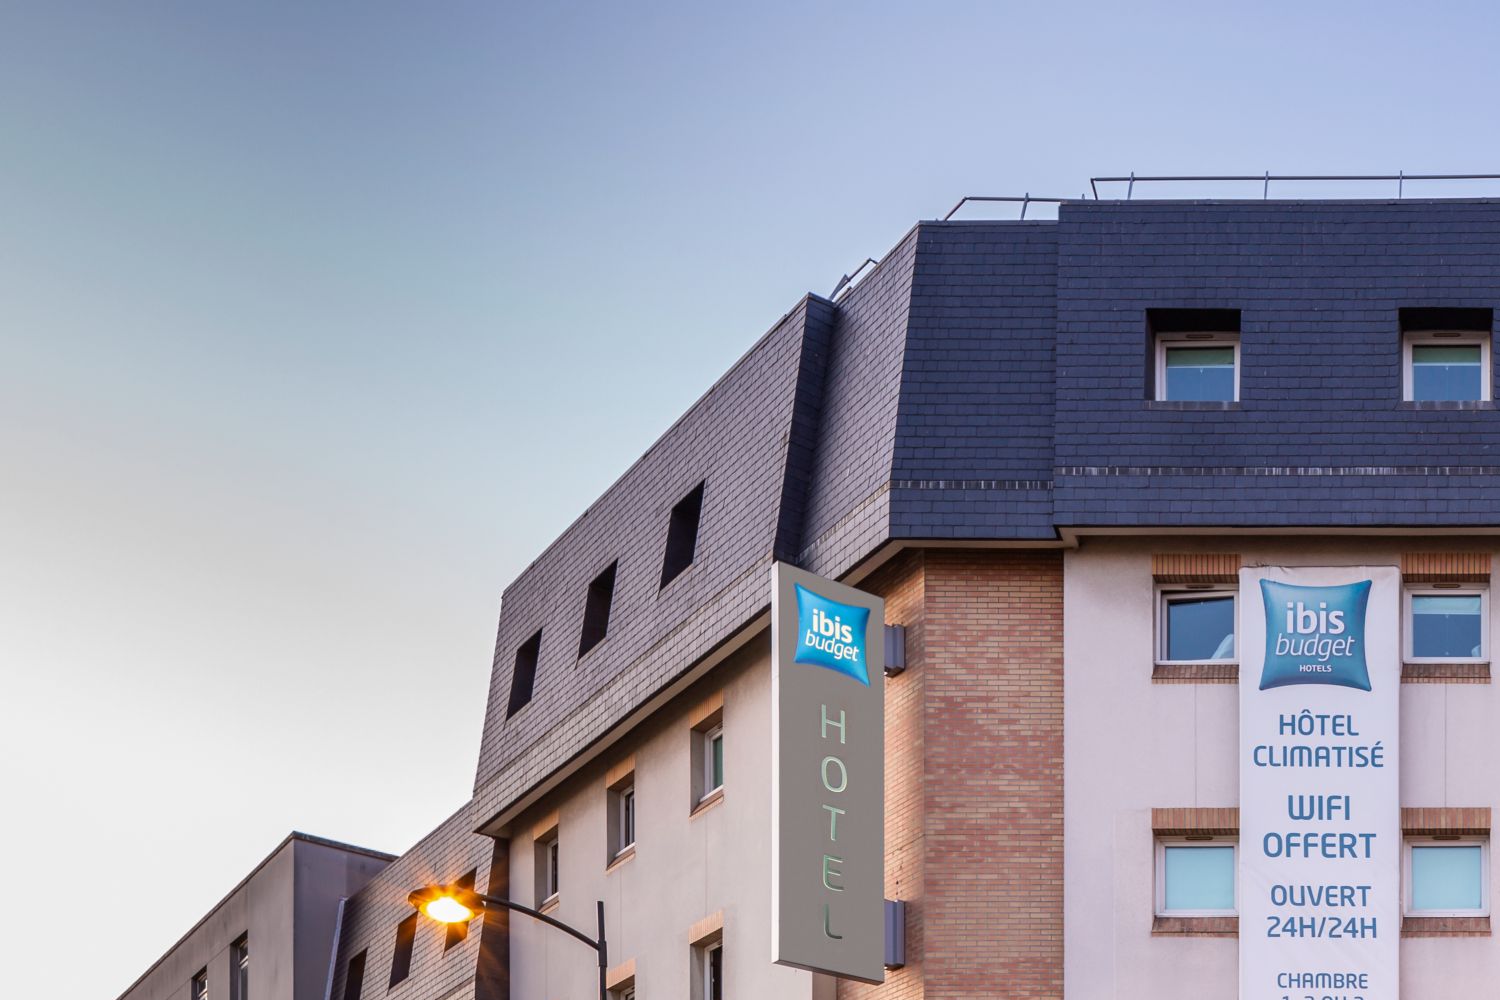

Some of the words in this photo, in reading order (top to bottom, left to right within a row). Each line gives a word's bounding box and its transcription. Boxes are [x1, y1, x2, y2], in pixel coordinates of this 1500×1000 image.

[811, 608, 853, 644] ibis
[1286, 601, 1345, 634] ibis
[804, 632, 860, 663] budget
[1275, 632, 1355, 662] budget
[1299, 664, 1332, 673] HOTELS
[1279, 708, 1360, 737] HÔTEL
[1253, 740, 1384, 768] CLIMATISÉ
[820, 703, 848, 941] HOTEL
[1287, 795, 1351, 821] WIFI
[1263, 832, 1377, 859] OFFERT
[1270, 884, 1372, 907] OUVERT
[1266, 915, 1377, 939] 24H/24H
[1277, 972, 1369, 990] CHAMBRE
